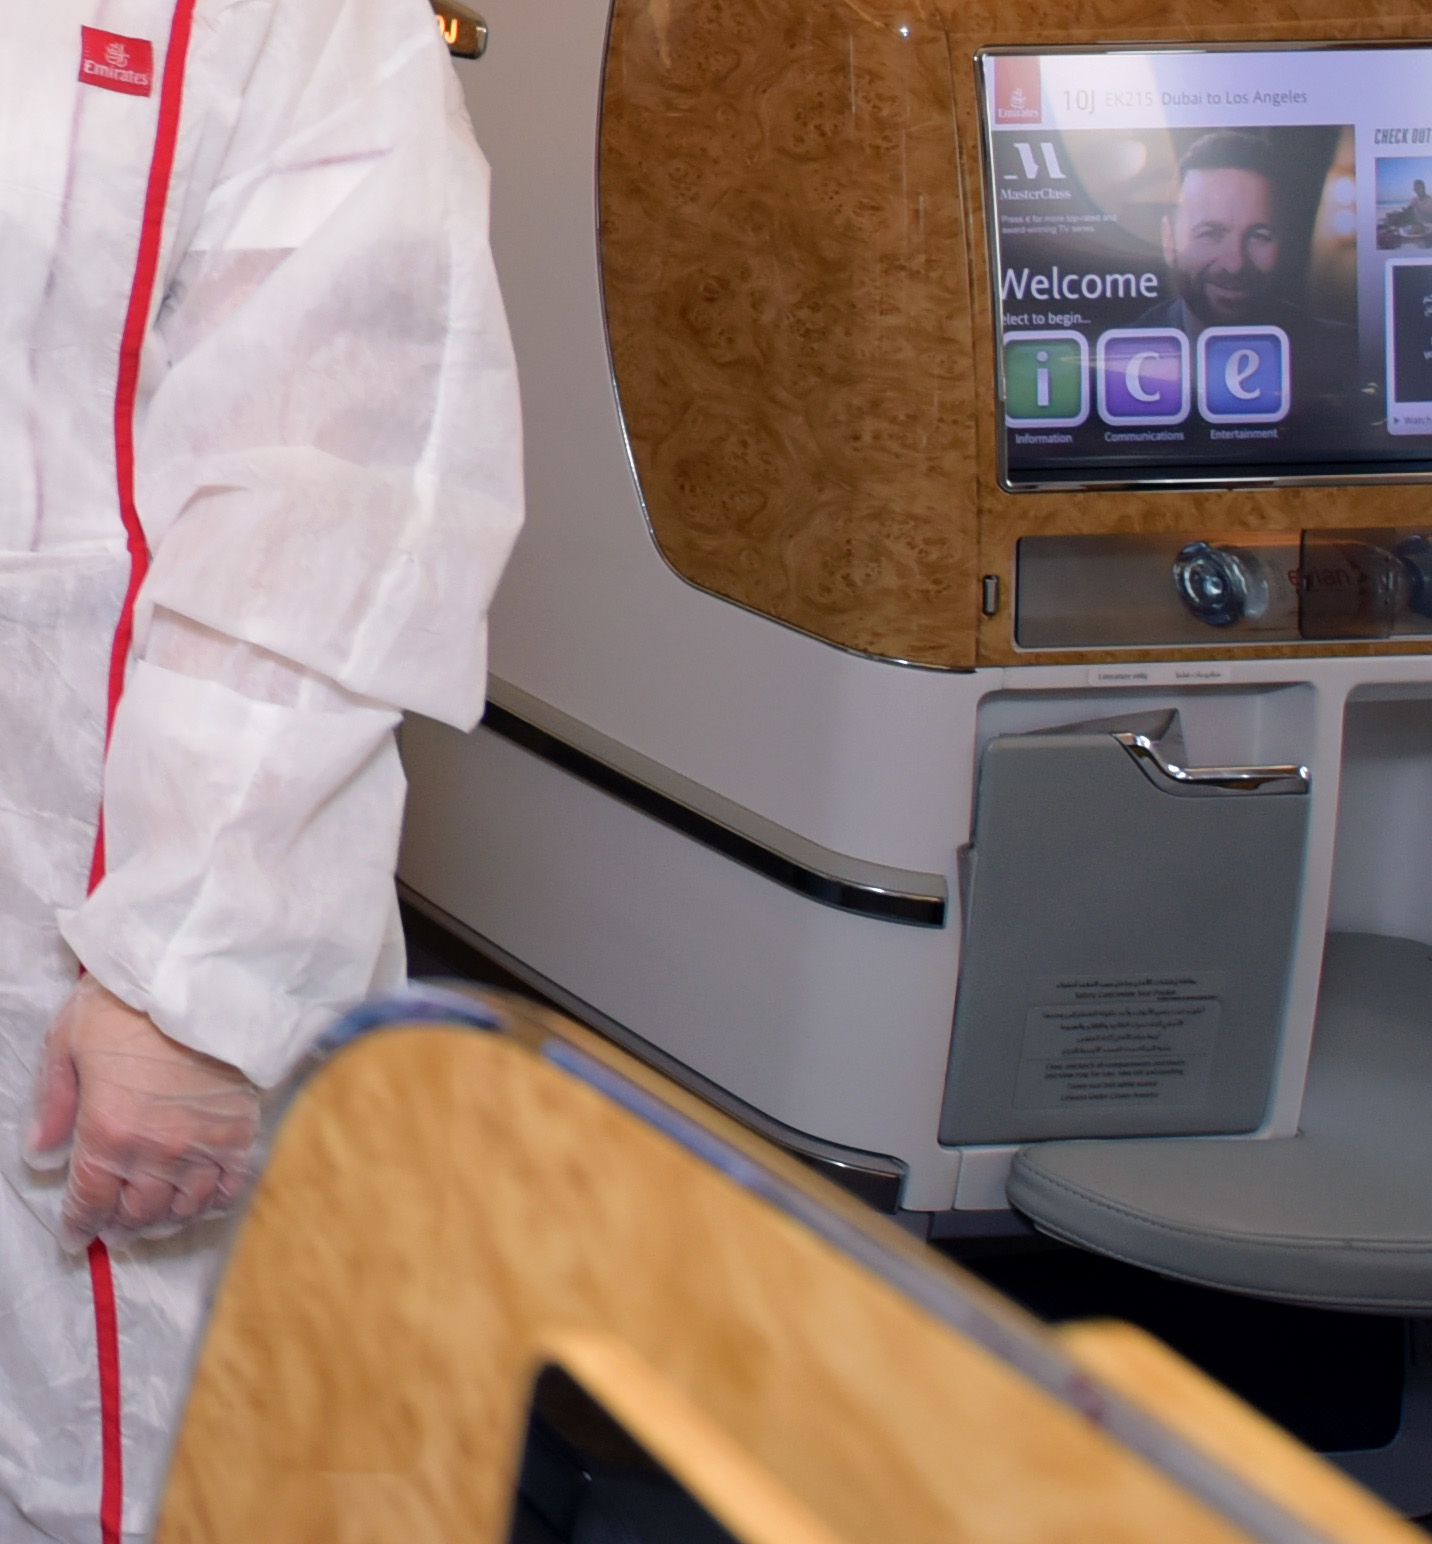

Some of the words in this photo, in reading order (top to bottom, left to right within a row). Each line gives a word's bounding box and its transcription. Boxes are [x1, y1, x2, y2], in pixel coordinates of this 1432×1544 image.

[83, 59, 149, 86] Emirates
[1063, 89, 1095, 115] 10J
[1105, 91, 1154, 107] EK215
[1161, 91, 1202, 105] Dubai
[1206, 92, 1221, 104] to
[1225, 91, 1248, 104] Los
[1252, 89, 1307, 106] Angeles
[1000, 188, 1071, 200] MasterClass
[1001, 266, 1158, 300] Welcome
[1001, 312, 1029, 325] elect
[1037, 351, 1050, 406] i
[1125, 351, 1160, 402] c
[1224, 349, 1260, 399] e
[1015, 433, 1072, 443] Information
[1104, 430, 1184, 442] Communications
[1210, 428, 1278, 439] Entertainment
